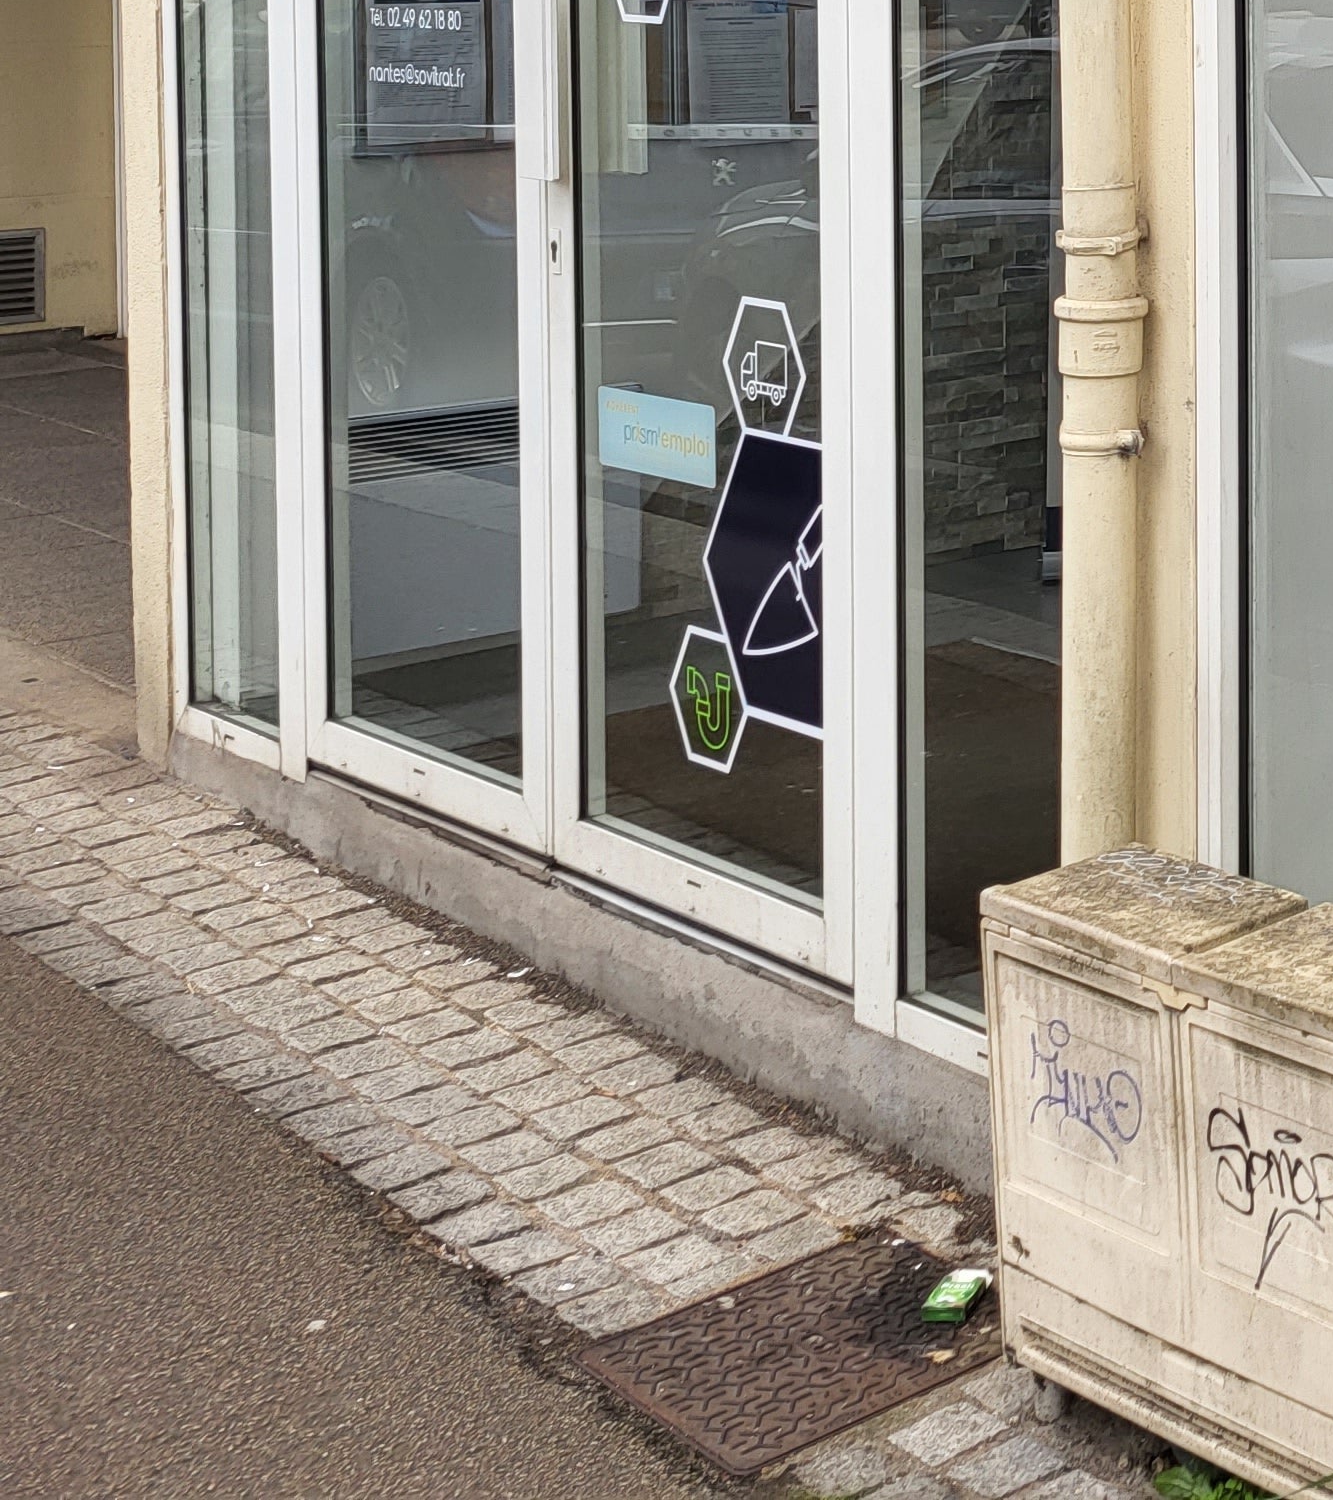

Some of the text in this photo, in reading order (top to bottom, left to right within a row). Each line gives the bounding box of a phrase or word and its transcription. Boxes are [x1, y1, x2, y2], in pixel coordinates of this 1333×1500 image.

[369, 6, 462, 31] Tél. 02 49 62 18 80
[369, 63, 466, 89] nantes@sovitrat.fr
